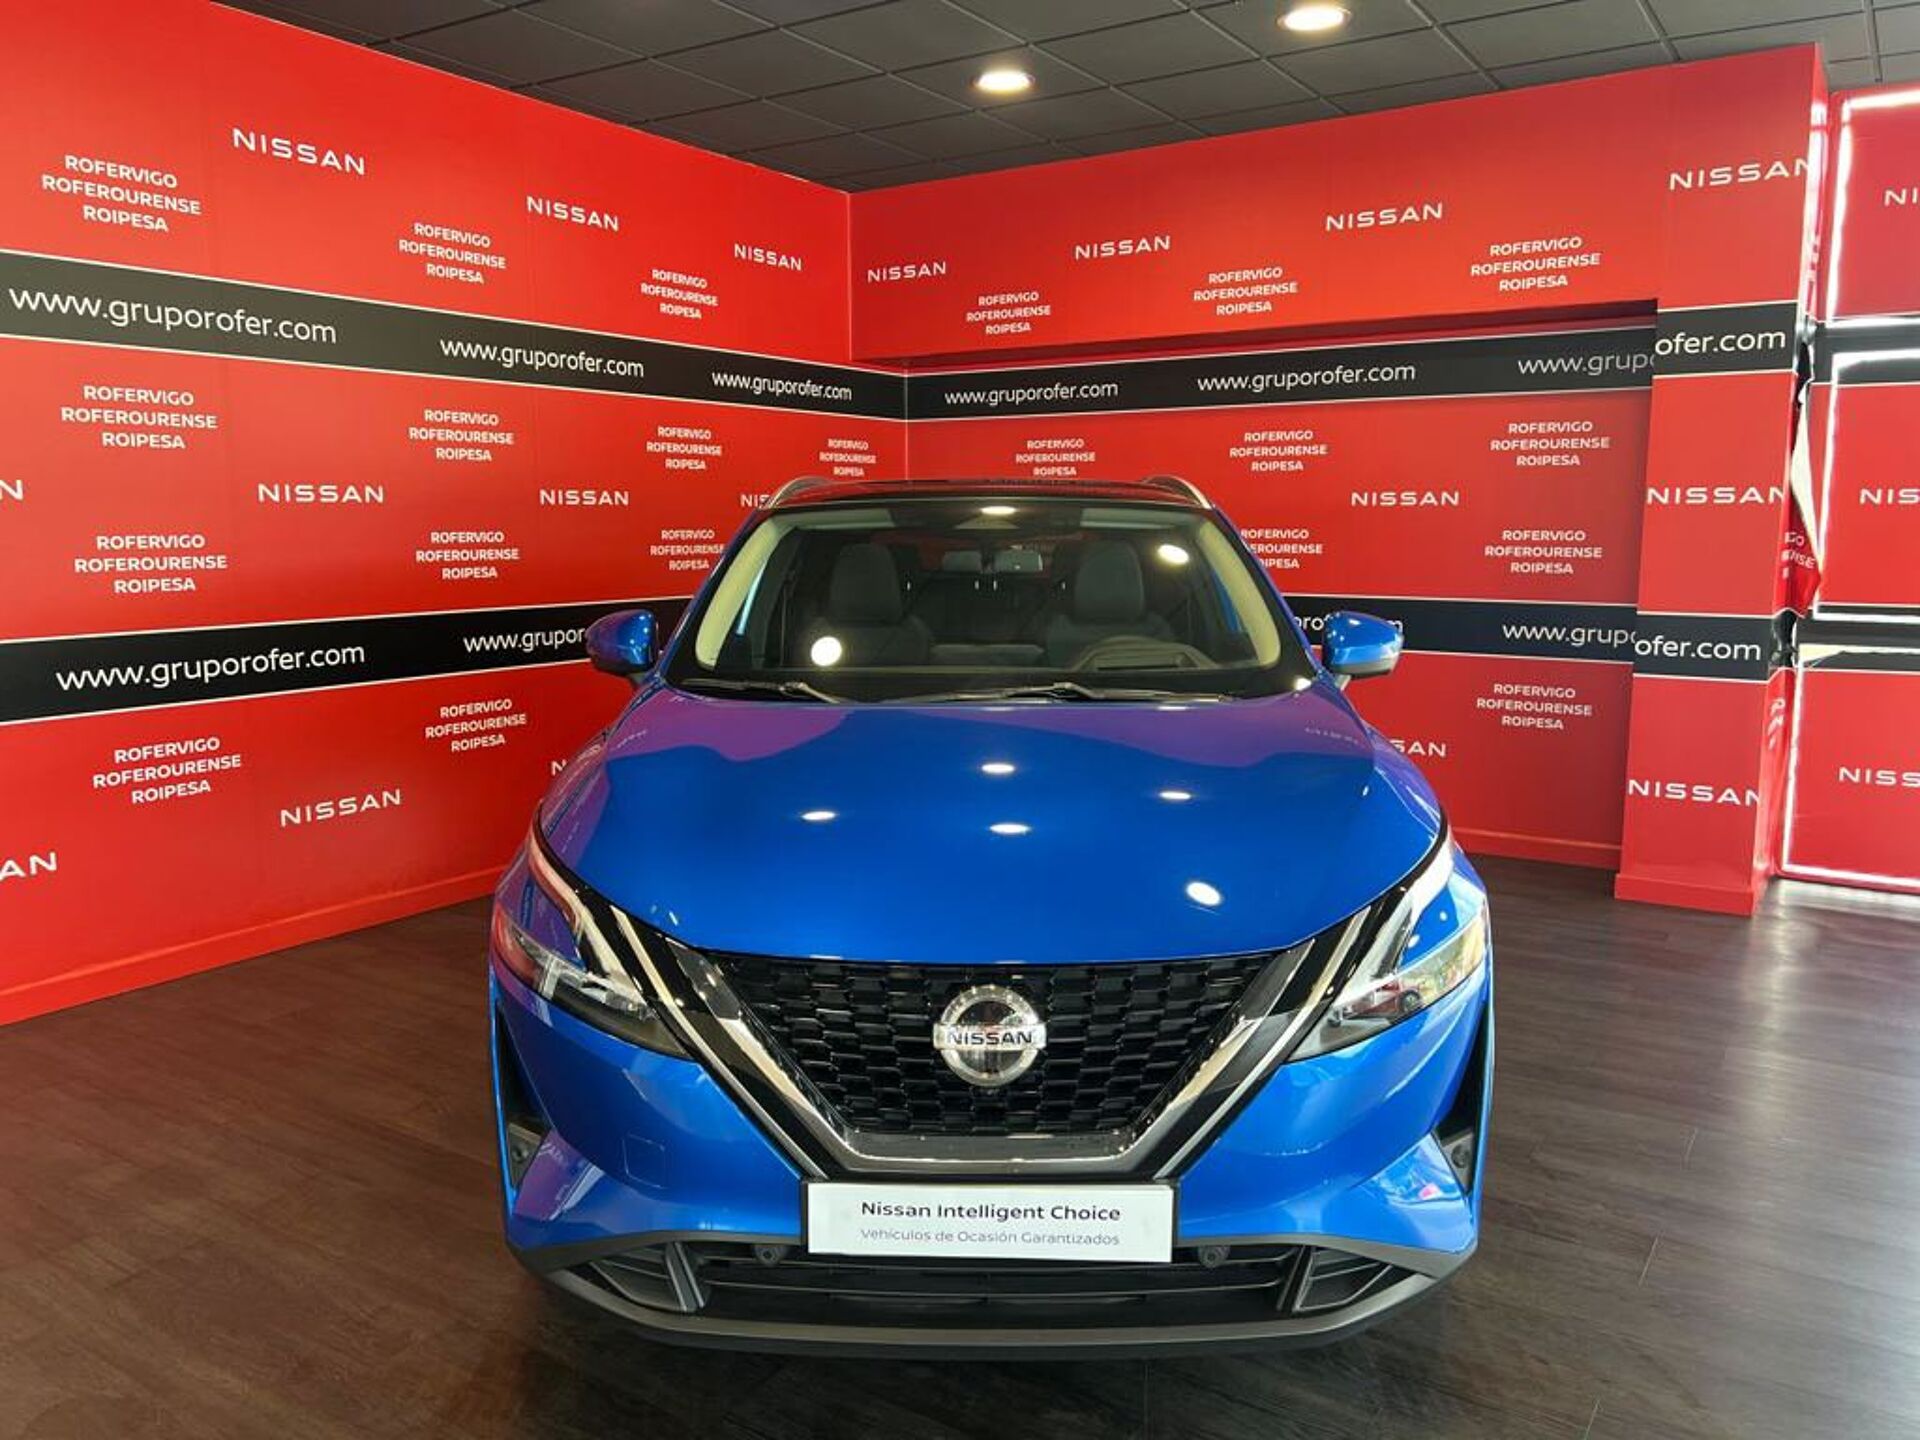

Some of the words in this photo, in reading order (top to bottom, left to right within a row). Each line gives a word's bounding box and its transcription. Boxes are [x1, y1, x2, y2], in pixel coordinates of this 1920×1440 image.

[233, 128, 365, 175] NISSAN
[64, 154, 178, 188] ROFERVIGO
[42, 174, 201, 216] ROFEROURENSE
[82, 204, 168, 233] ROIPESA
[527, 196, 619, 231] NISSAN
[1326, 202, 1444, 232] NISSAN
[414, 222, 490, 247] ROFERVIGO
[398, 239, 506, 269] ROFEROURENSE
[1075, 236, 1171, 261] NISSAN
[1490, 236, 1583, 257] ROFERVIGO
[734, 243, 802, 271] NISSAN
[1471, 252, 1600, 276] ROFEROURENSE
[426, 264, 484, 284] ROIPESA
[651, 269, 707, 288] ROFERVIGO
[868, 261, 946, 282] NISSAN
[1208, 267, 1283, 284] ROFERVIGO
[1193, 281, 1298, 302] ROFEROURENSE
[1499, 275, 1568, 292] ROIPESA
[641, 283, 718, 306] ROFEROURENSE
[978, 291, 1039, 307] ROFERVIGO
[9, 288, 337, 343] www.gruporofer.com
[660, 303, 702, 319] ROIPESA
[966, 305, 1051, 323] ROFEROURENSE
[1216, 301, 1272, 316] ROIPESA
[985, 322, 1031, 335] ROIPESA
[440, 339, 644, 377] www.gruporofer.com
[712, 372, 852, 401] www.gruporofer.com
[1197, 363, 1416, 393] www.gruporofer.com
[83, 386, 194, 406] ROFERVIGO
[945, 380, 1119, 405] www.gruporofer.com
[60, 407, 218, 428] ROFEROURENSE
[424, 410, 499, 426] ROFERVIGO
[408, 427, 514, 444] ROFEROURENSE
[657, 426, 712, 440] ROFERVIGO
[1244, 430, 1313, 442] ROFERVIGO
[1508, 421, 1593, 434] ROFERVIGO
[102, 432, 186, 450] ROIPESA
[646, 441, 722, 456] ROFEROURENSE
[1027, 438, 1084, 450] ROFERVIGO
[1490, 437, 1610, 451] ROFEROURENSE
[436, 448, 492, 461] ROIPESA
[1015, 451, 1096, 463] ROFEROURENSE
[1230, 444, 1328, 458] ROFEROURENSE
[665, 457, 706, 470] ROIPESA
[1251, 460, 1304, 472] ROIPESA
[1516, 454, 1580, 467] ROIPESA
[1033, 466, 1077, 476] ROIPESA
[258, 484, 384, 503] NISSAN
[540, 490, 629, 506] NISSAN
[1351, 492, 1460, 508] NISSAN
[96, 534, 206, 550] ROFERVIGO
[430, 532, 504, 544] ROFERVIGO
[661, 529, 714, 541] ROFERVIGO
[1502, 529, 1586, 541] ROFERVIGO
[416, 548, 519, 562] ROFEROURENSE
[1484, 545, 1602, 558] ROFEROURENSE
[74, 554, 228, 572] ROFEROURENSE
[669, 559, 709, 571] ROIPESA
[1510, 562, 1574, 574] ROIPESA
[442, 567, 498, 580] ROIPESA
[114, 577, 196, 594] ROIPESA
[56, 645, 365, 690] www.gruporofer.com
[1494, 683, 1576, 699] ROFERVIGO
[440, 698, 512, 718] ROFERVIGO
[1477, 698, 1592, 716] ROFEROURENSE
[424, 714, 527, 738] ROFEROURENSE
[1502, 715, 1564, 729] ROIPESA
[114, 737, 220, 764] ROFERVIGO
[451, 734, 506, 752] ROIPESA
[93, 754, 241, 788] ROFEROURENSE
[131, 779, 211, 804] ROIPESA
[280, 788, 402, 827] NISSAN
[949, 1031, 1032, 1045] NISSAN
[862, 1202, 931, 1218] Nissan
[938, 1205, 1044, 1222] Intelligent
[1051, 1206, 1122, 1221] Choice
[861, 1229, 931, 1241] Vehículos
[935, 1231, 953, 1242] de
[957, 1231, 1017, 1243] Ocasión
[1021, 1232, 1119, 1245] Garantizados
